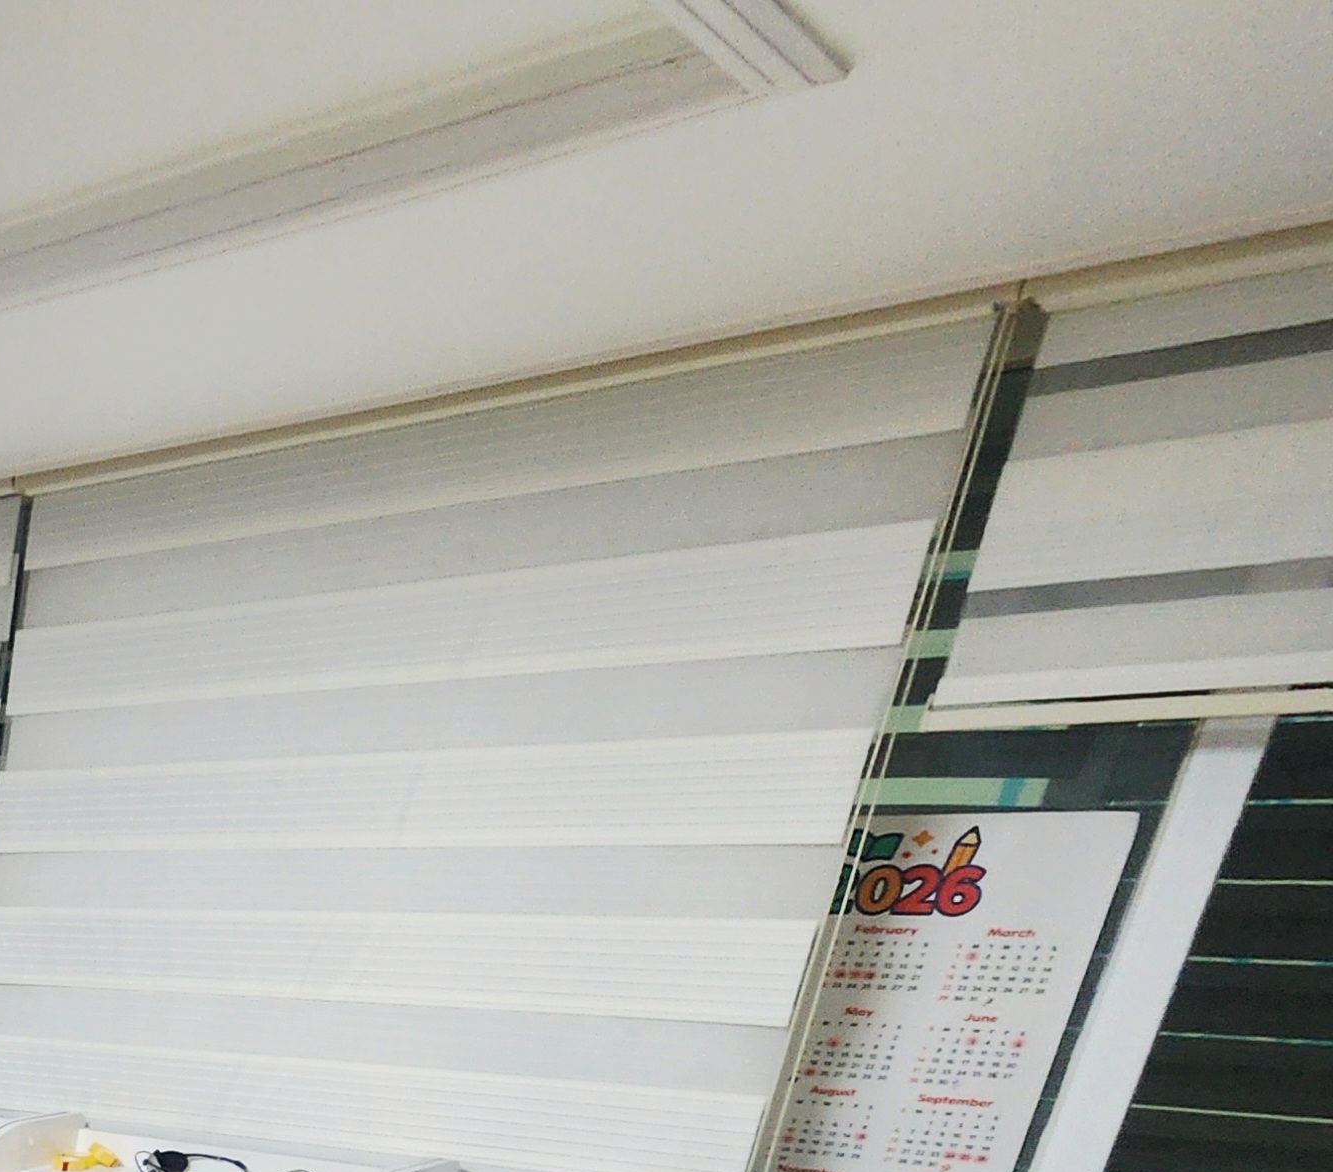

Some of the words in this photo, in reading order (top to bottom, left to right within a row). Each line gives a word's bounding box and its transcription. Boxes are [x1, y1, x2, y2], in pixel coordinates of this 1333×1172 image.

[855, 924, 919, 936] February
[988, 928, 1036, 938] March
[845, 1006, 874, 1018] May
[964, 1013, 999, 1023] June
[810, 1085, 857, 1098] August
[917, 1094, 994, 1109] September
